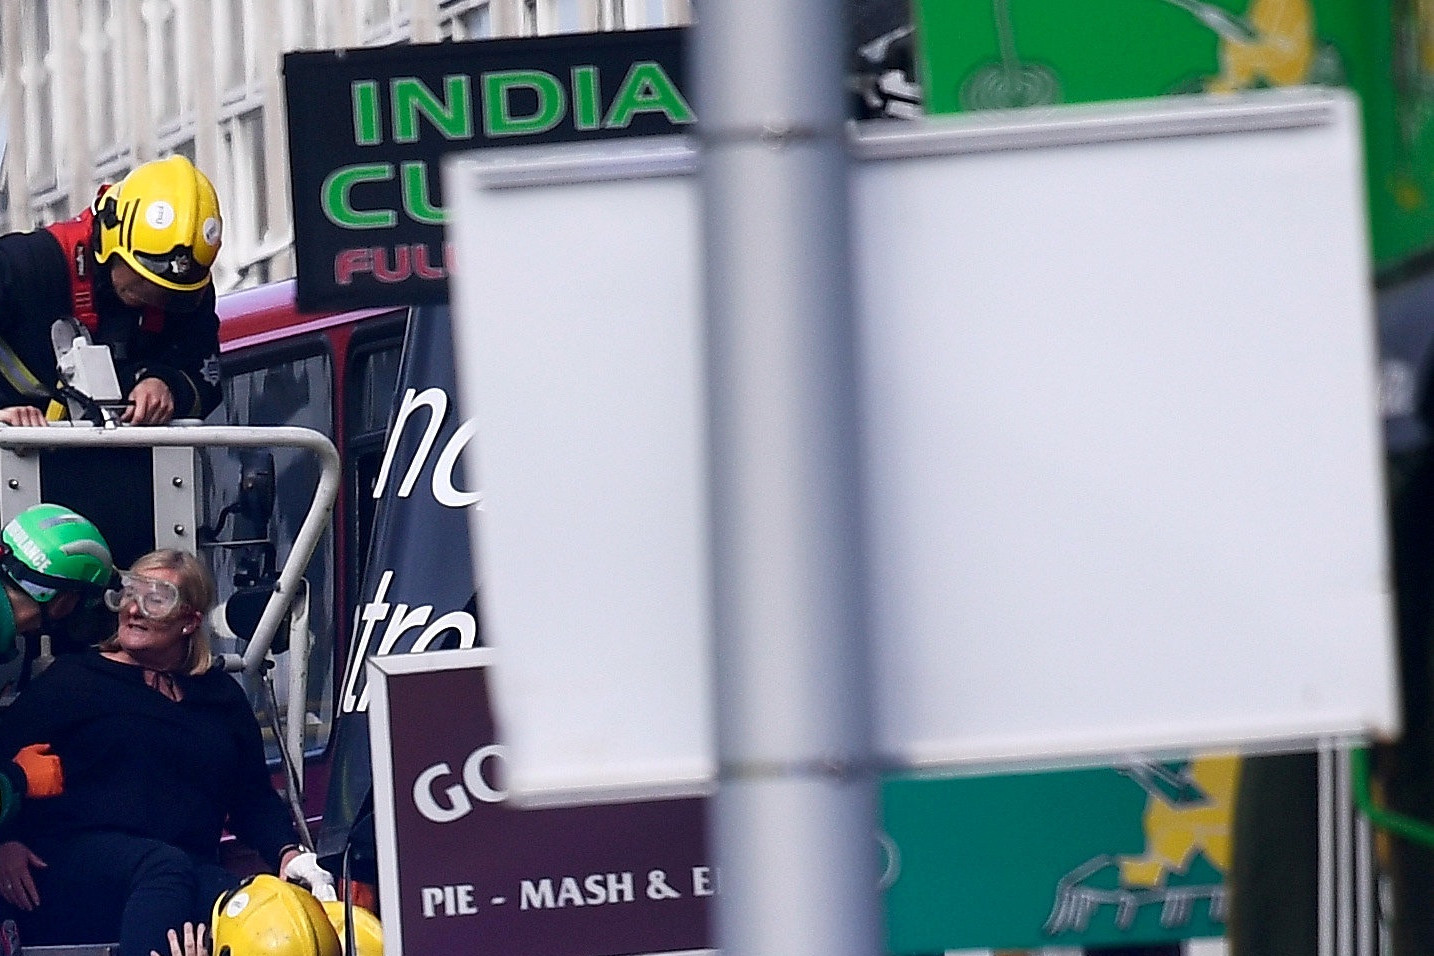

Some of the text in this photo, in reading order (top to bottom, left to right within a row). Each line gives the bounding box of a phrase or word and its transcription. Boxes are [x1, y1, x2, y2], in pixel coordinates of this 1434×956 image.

[351, 60, 697, 146] INDIA
[421, 885, 479, 918] PIE
[519, 871, 635, 910] MASH
[646, 870, 682, 900] &
